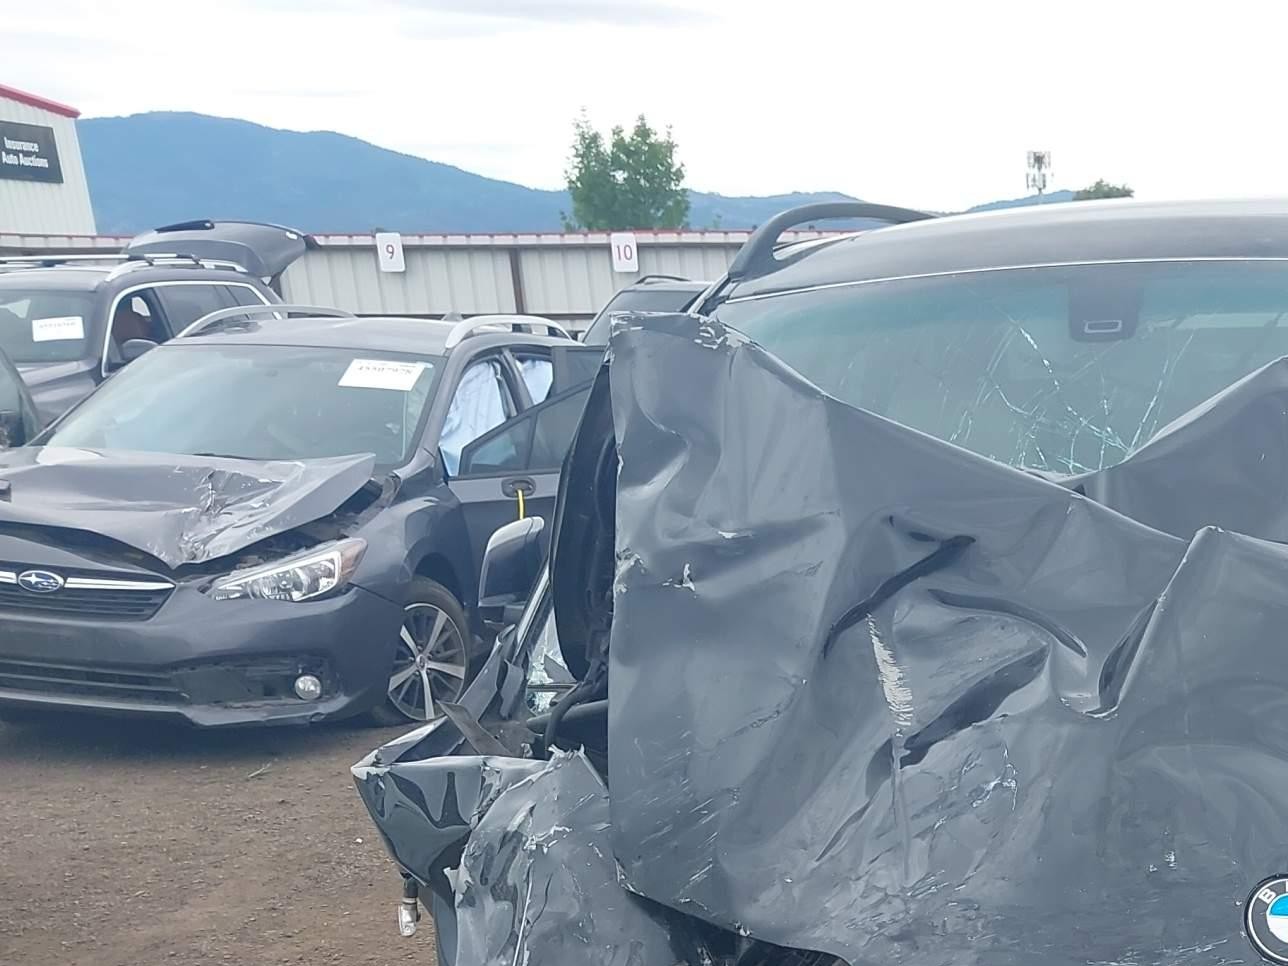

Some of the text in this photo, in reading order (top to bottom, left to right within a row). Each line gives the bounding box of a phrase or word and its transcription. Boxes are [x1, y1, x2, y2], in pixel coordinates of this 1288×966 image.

[4, 136, 39, 152] Insurance
[1, 151, 49, 168] Auto Auctions
[386, 244, 395, 260] 9
[616, 244, 633, 261] 10
